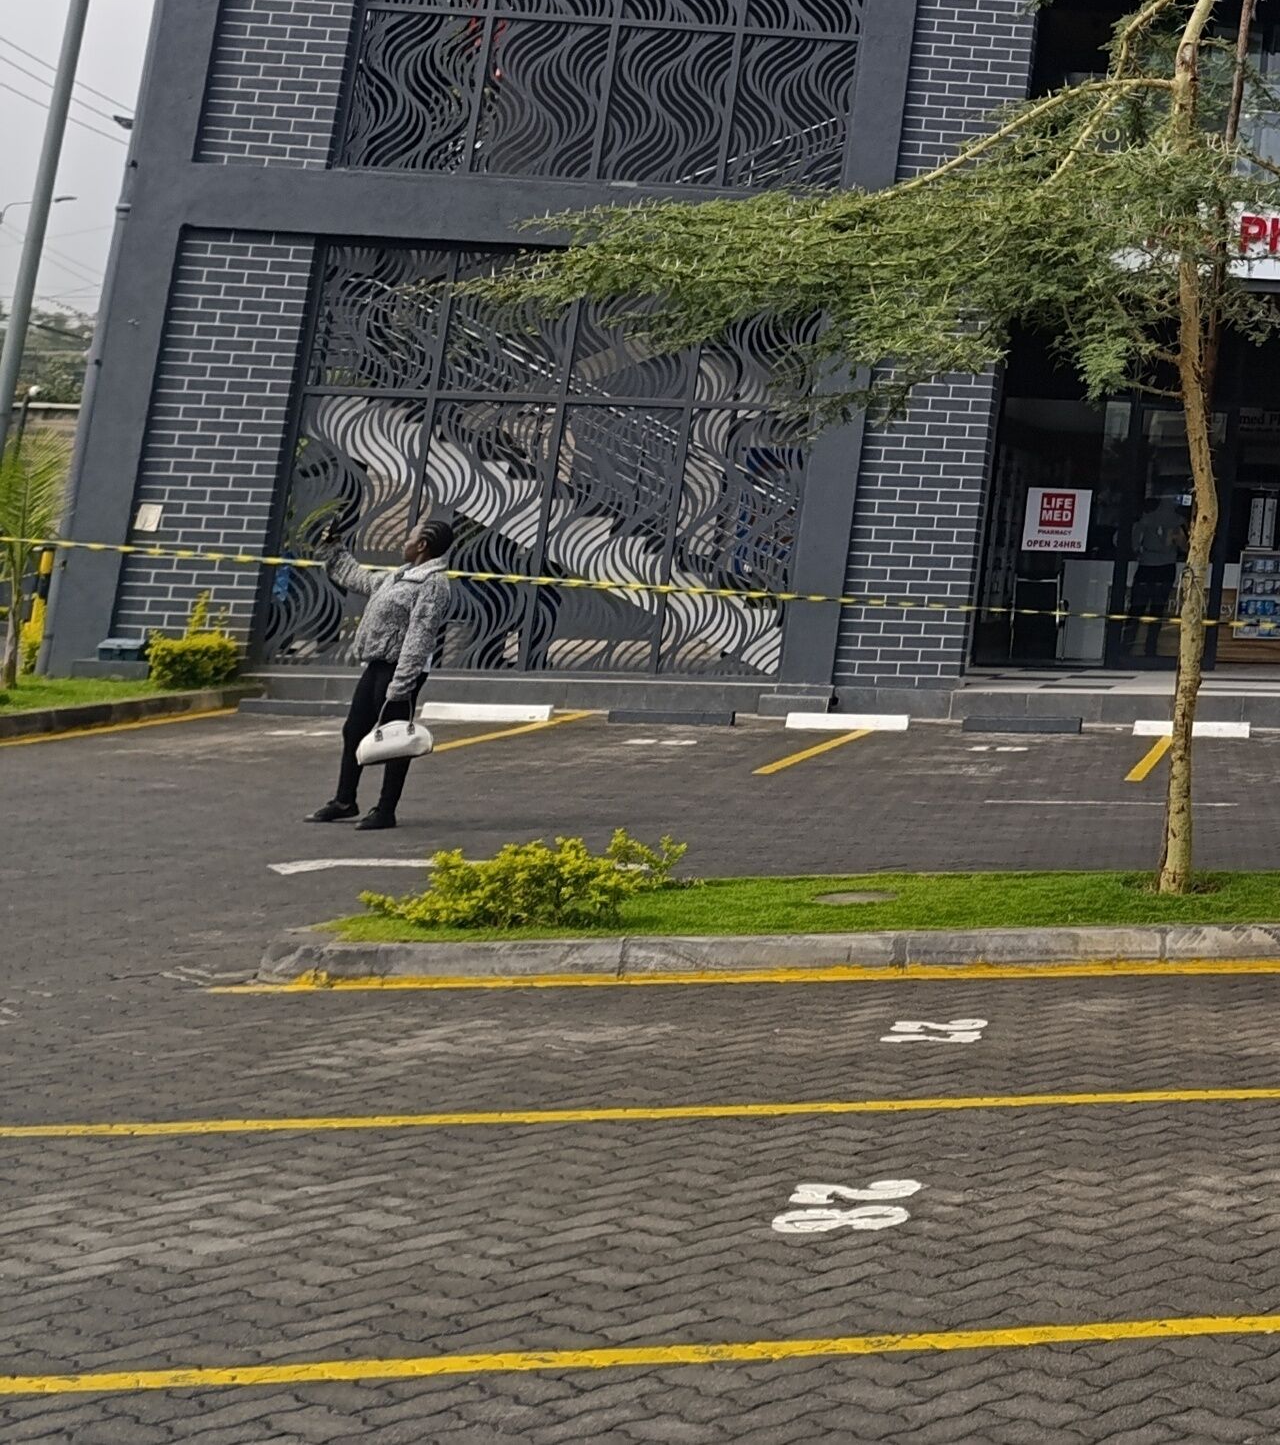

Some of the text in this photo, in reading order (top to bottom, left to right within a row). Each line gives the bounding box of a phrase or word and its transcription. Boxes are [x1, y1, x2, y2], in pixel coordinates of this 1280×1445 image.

[1043, 497, 1074, 510] LIFE
[1041, 509, 1072, 522] MED
[1026, 539, 1082, 549] OPEN 24HRS
